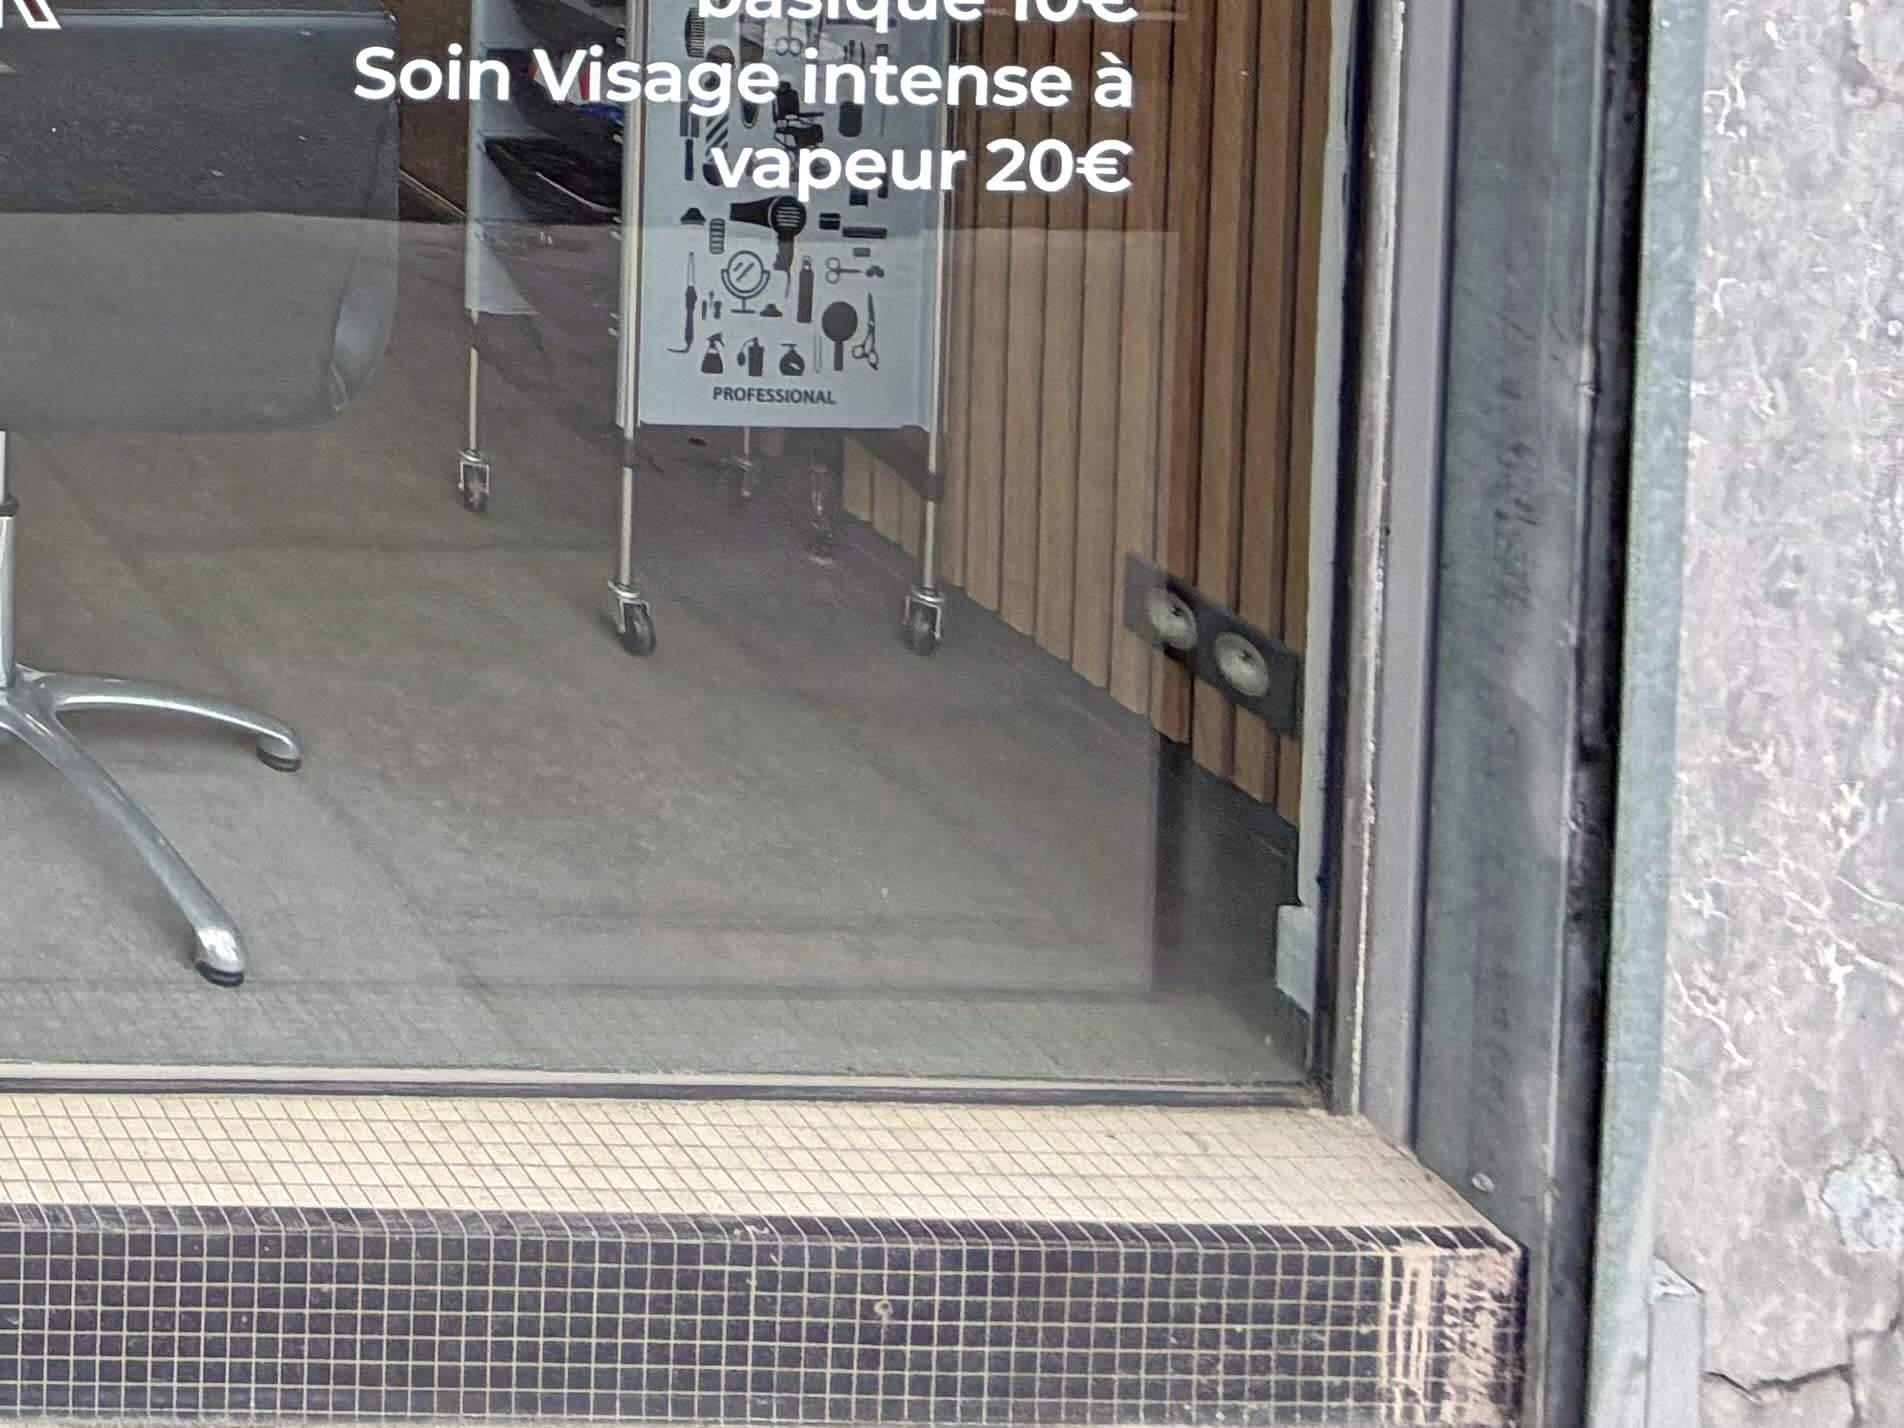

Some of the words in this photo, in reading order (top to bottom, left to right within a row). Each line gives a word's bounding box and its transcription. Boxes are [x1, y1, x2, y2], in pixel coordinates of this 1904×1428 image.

[354, 42, 510, 101] Soin
[533, 44, 779, 117] Visage
[804, 47, 1072, 107] intense
[1094, 51, 1133, 108] à
[710, 147, 966, 203] vapeur
[986, 138, 1133, 193] 20€
[712, 386, 837, 405] PROFESSIONAL
